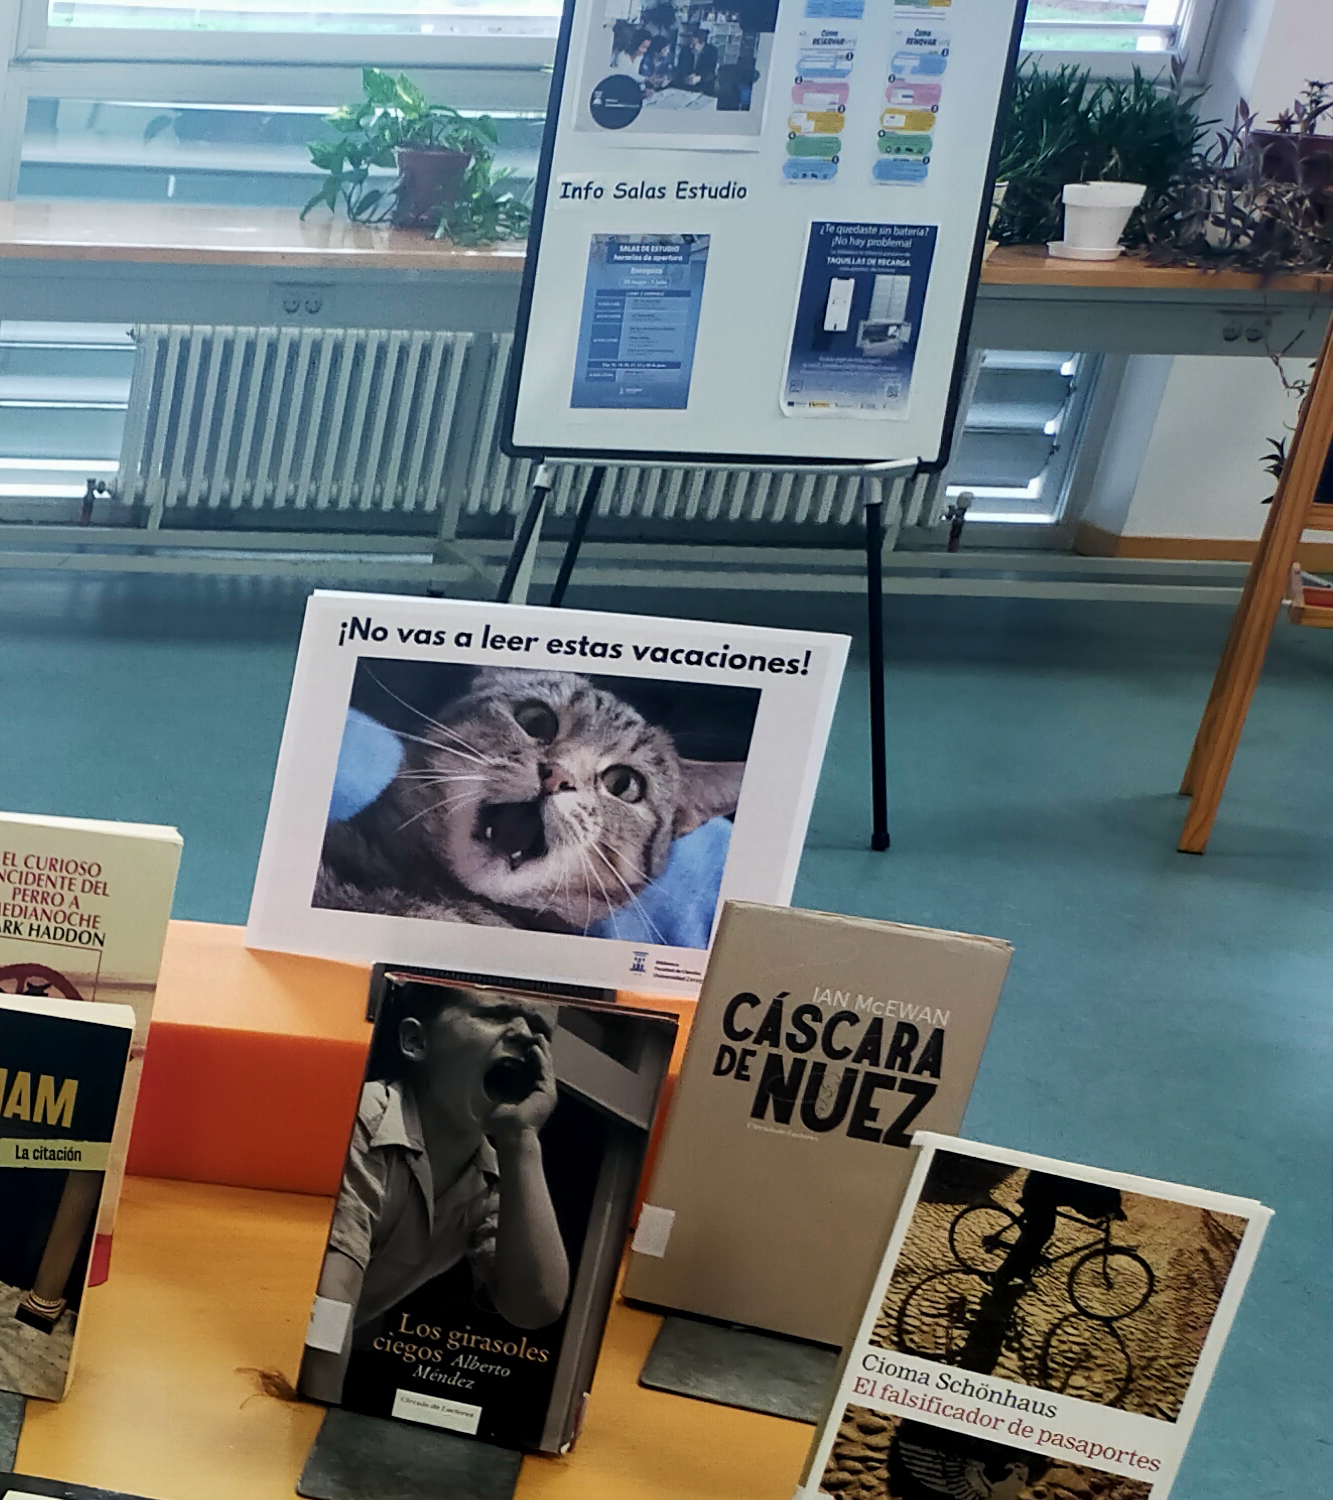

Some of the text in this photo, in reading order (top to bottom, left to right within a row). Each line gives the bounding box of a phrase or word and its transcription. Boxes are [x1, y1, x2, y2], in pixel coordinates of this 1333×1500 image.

[559, 181, 747, 201] Info Salas Estudio
[849, 237, 865, 248] hay
[338, 616, 813, 676] ¡No vas a leer estas vacaciones!
[1, 851, 103, 879] EL CURIOSO
[11, 886, 81, 910] PERRO A
[81, 877, 110, 898] DEL
[28, 922, 105, 948] HADDON
[813, 986, 951, 1028] IAN McEWAN
[721, 990, 946, 1080] CÁSCARA
[712, 1044, 939, 1150] DE NUEZ
[15, 1145, 83, 1162] La citación
[373, 1331, 511, 1378] ciegos Alberto
[398, 1312, 551, 1363] Los girasoles
[412, 1364, 475, 1390] Méndez
[861, 1354, 1058, 1420] Cioma Schönhaus
[851, 1376, 1163, 1473] El falsificador de pasaportes
